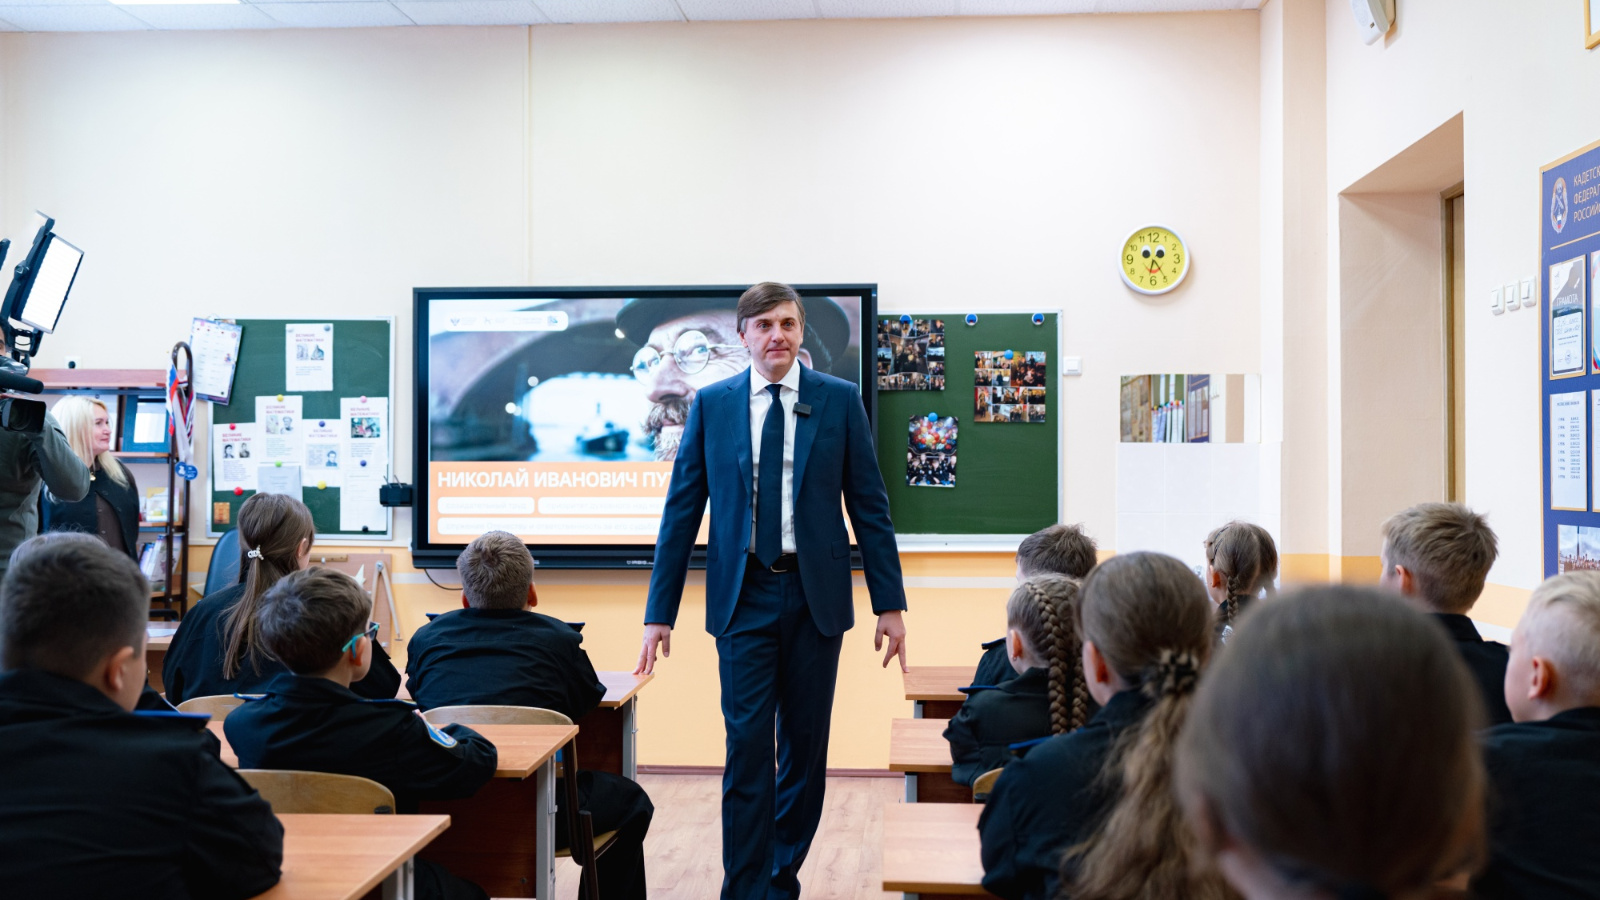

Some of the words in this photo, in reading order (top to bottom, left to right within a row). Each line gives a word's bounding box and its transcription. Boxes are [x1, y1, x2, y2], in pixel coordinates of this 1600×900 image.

[1573, 201, 1600, 223] РОССИЙ
[1147, 232, 1160, 243] 12
[1126, 254, 1134, 265] 9
[1173, 253, 1181, 264] 3
[1150, 276, 1157, 286] 6
[437, 467, 530, 488] НИКОЛАЙ
[534, 471, 638, 488] ИВАНОВИЧ
